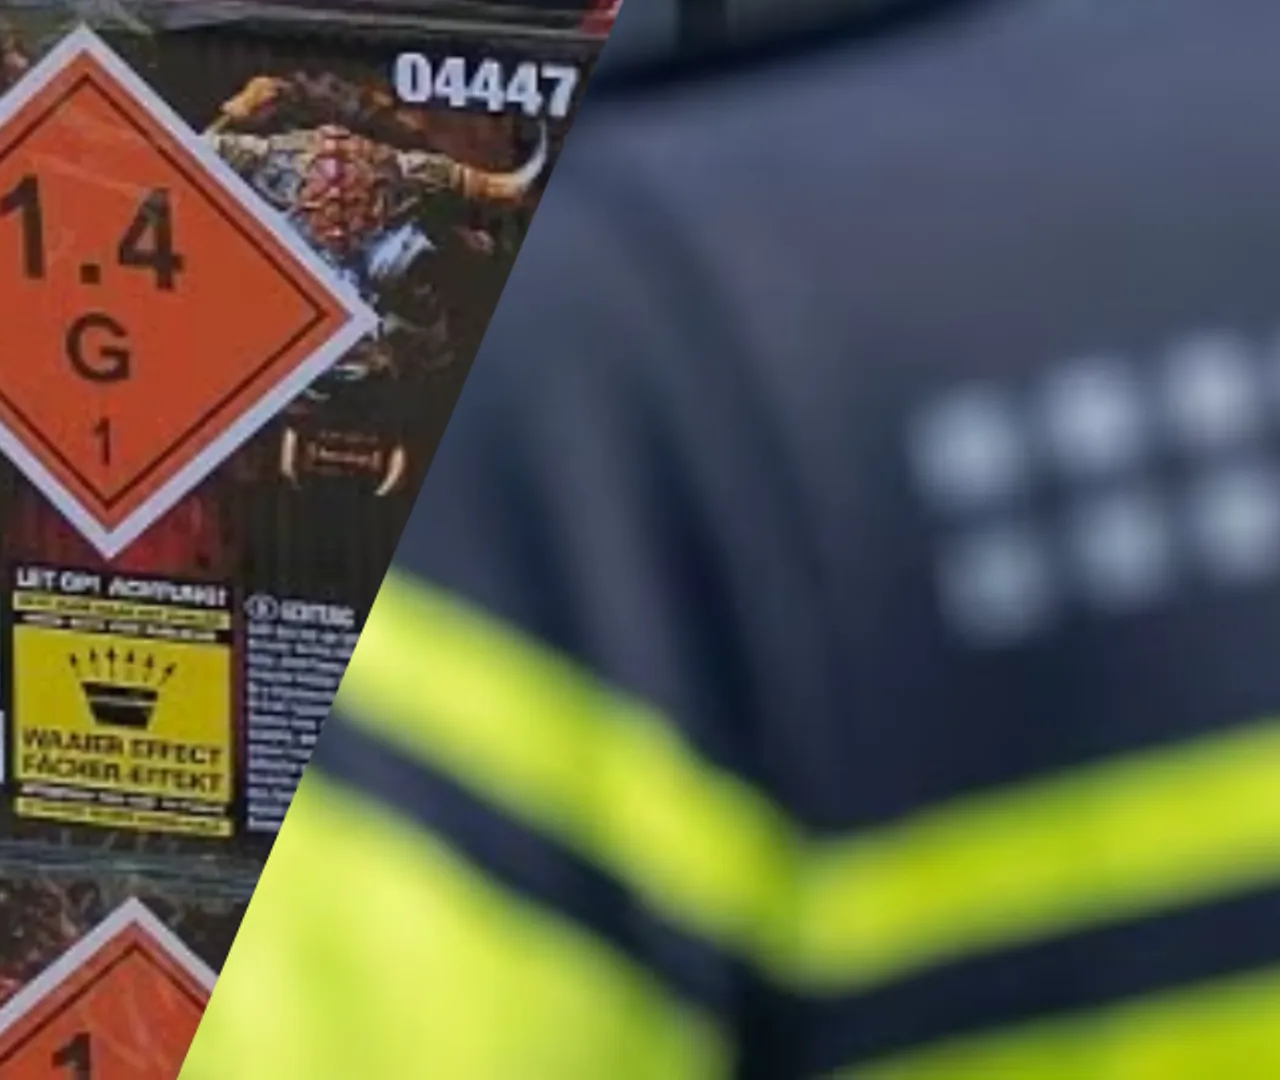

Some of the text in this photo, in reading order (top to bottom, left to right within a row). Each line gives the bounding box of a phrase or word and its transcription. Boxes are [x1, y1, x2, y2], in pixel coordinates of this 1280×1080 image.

[393, 52, 578, 118] 04447
[65, 313, 131, 383] G
[93, 418, 111, 466] 1
[131, 737, 223, 767] EFFECT
